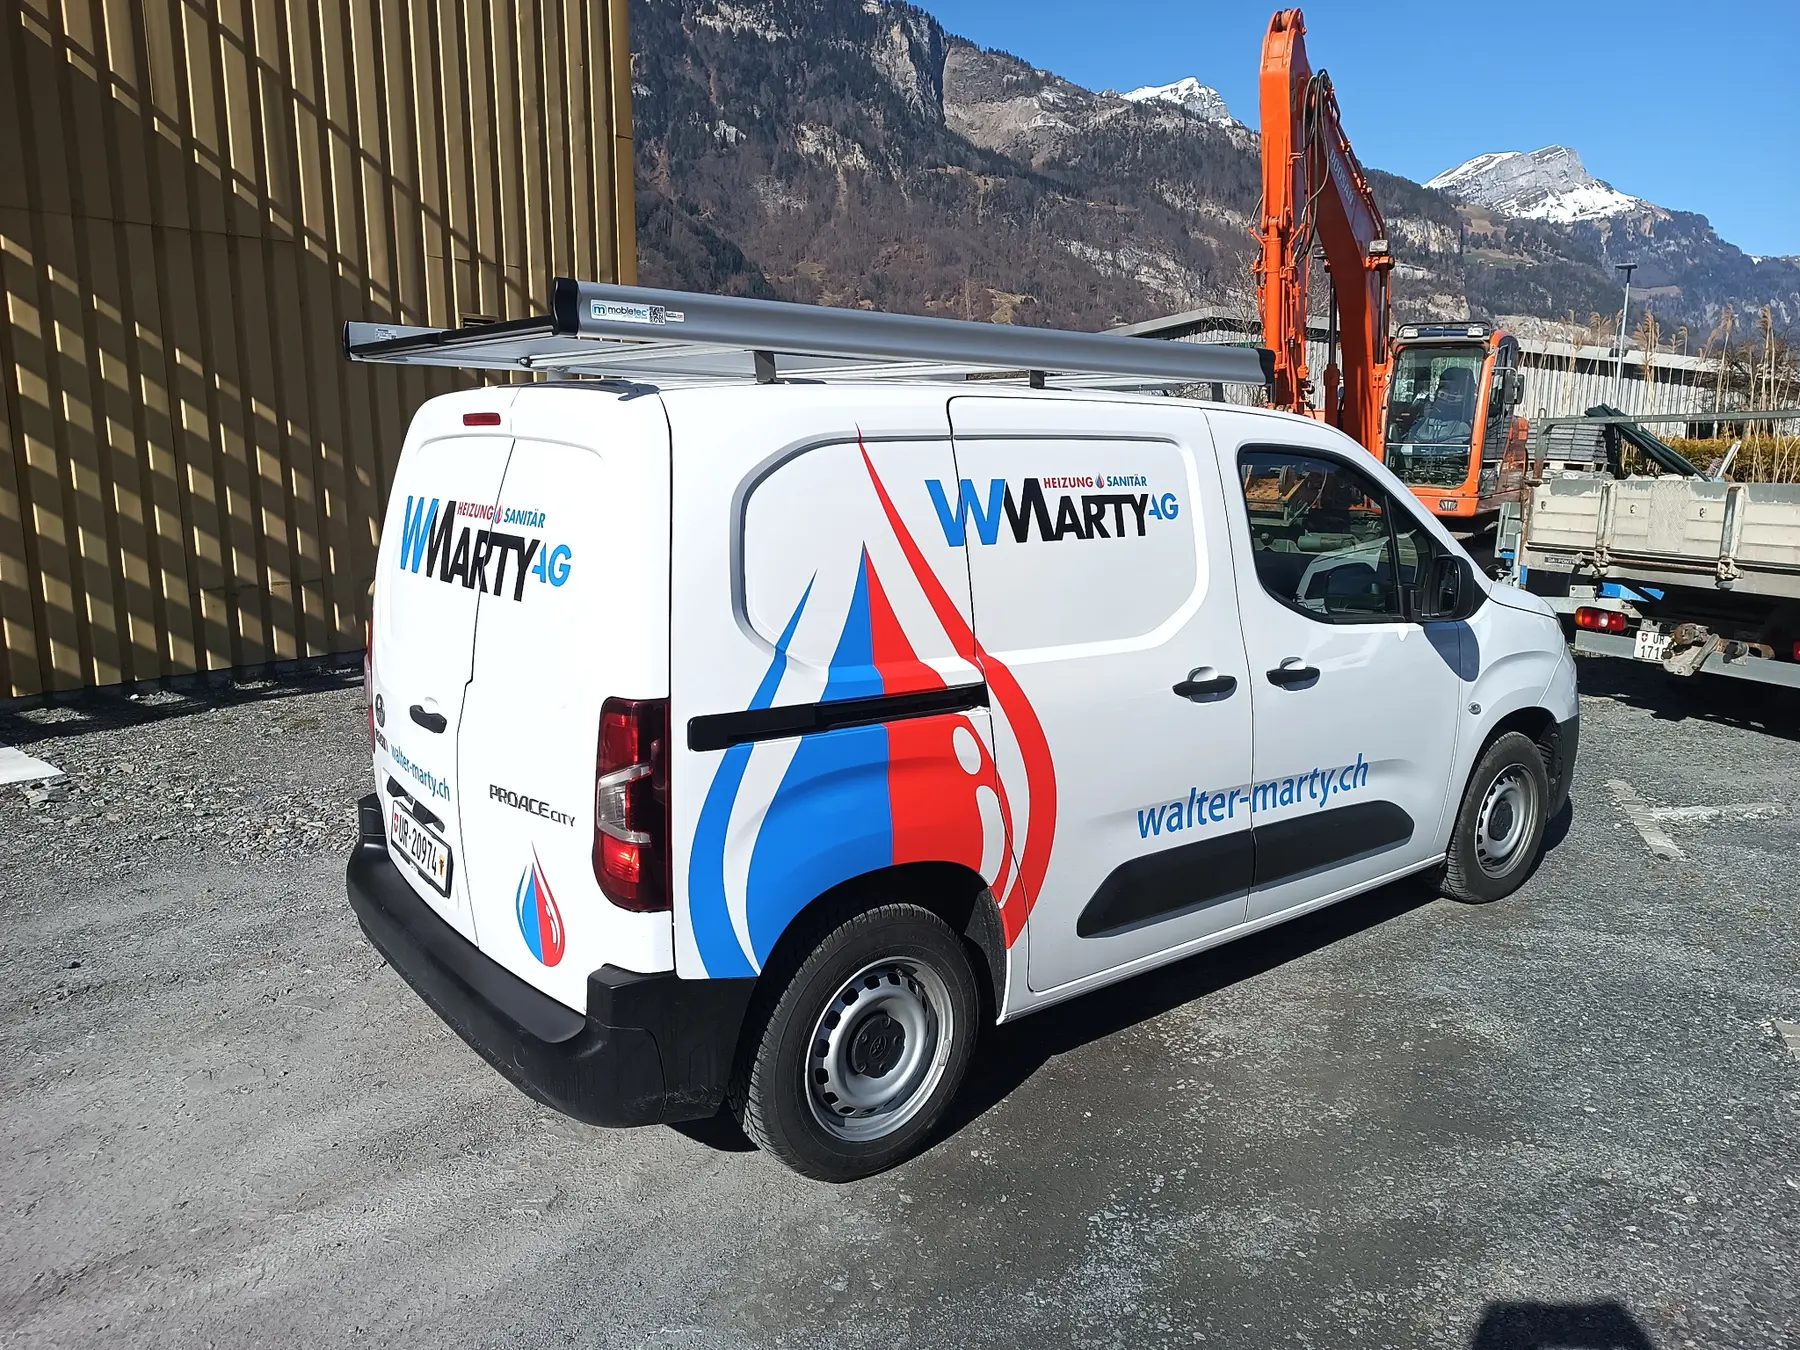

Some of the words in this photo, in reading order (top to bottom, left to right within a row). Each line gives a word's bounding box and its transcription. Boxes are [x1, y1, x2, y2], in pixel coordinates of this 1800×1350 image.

[1043, 477, 1094, 489] HEIZUNG
[1106, 474, 1148, 487] SANITÄR
[457, 502, 494, 521] HEIZUNG
[503, 508, 546, 528] SANITÄR
[1149, 492, 1179, 520] AG
[532, 543, 572, 588] AG
[1641, 645, 1669, 660] 171
[1653, 634, 1665, 645] UR
[391, 744, 451, 801] walter-marty.ch
[489, 784, 550, 819] PROACE
[550, 810, 576, 827] CITY
[1137, 752, 1369, 839] walter-marty.ch
